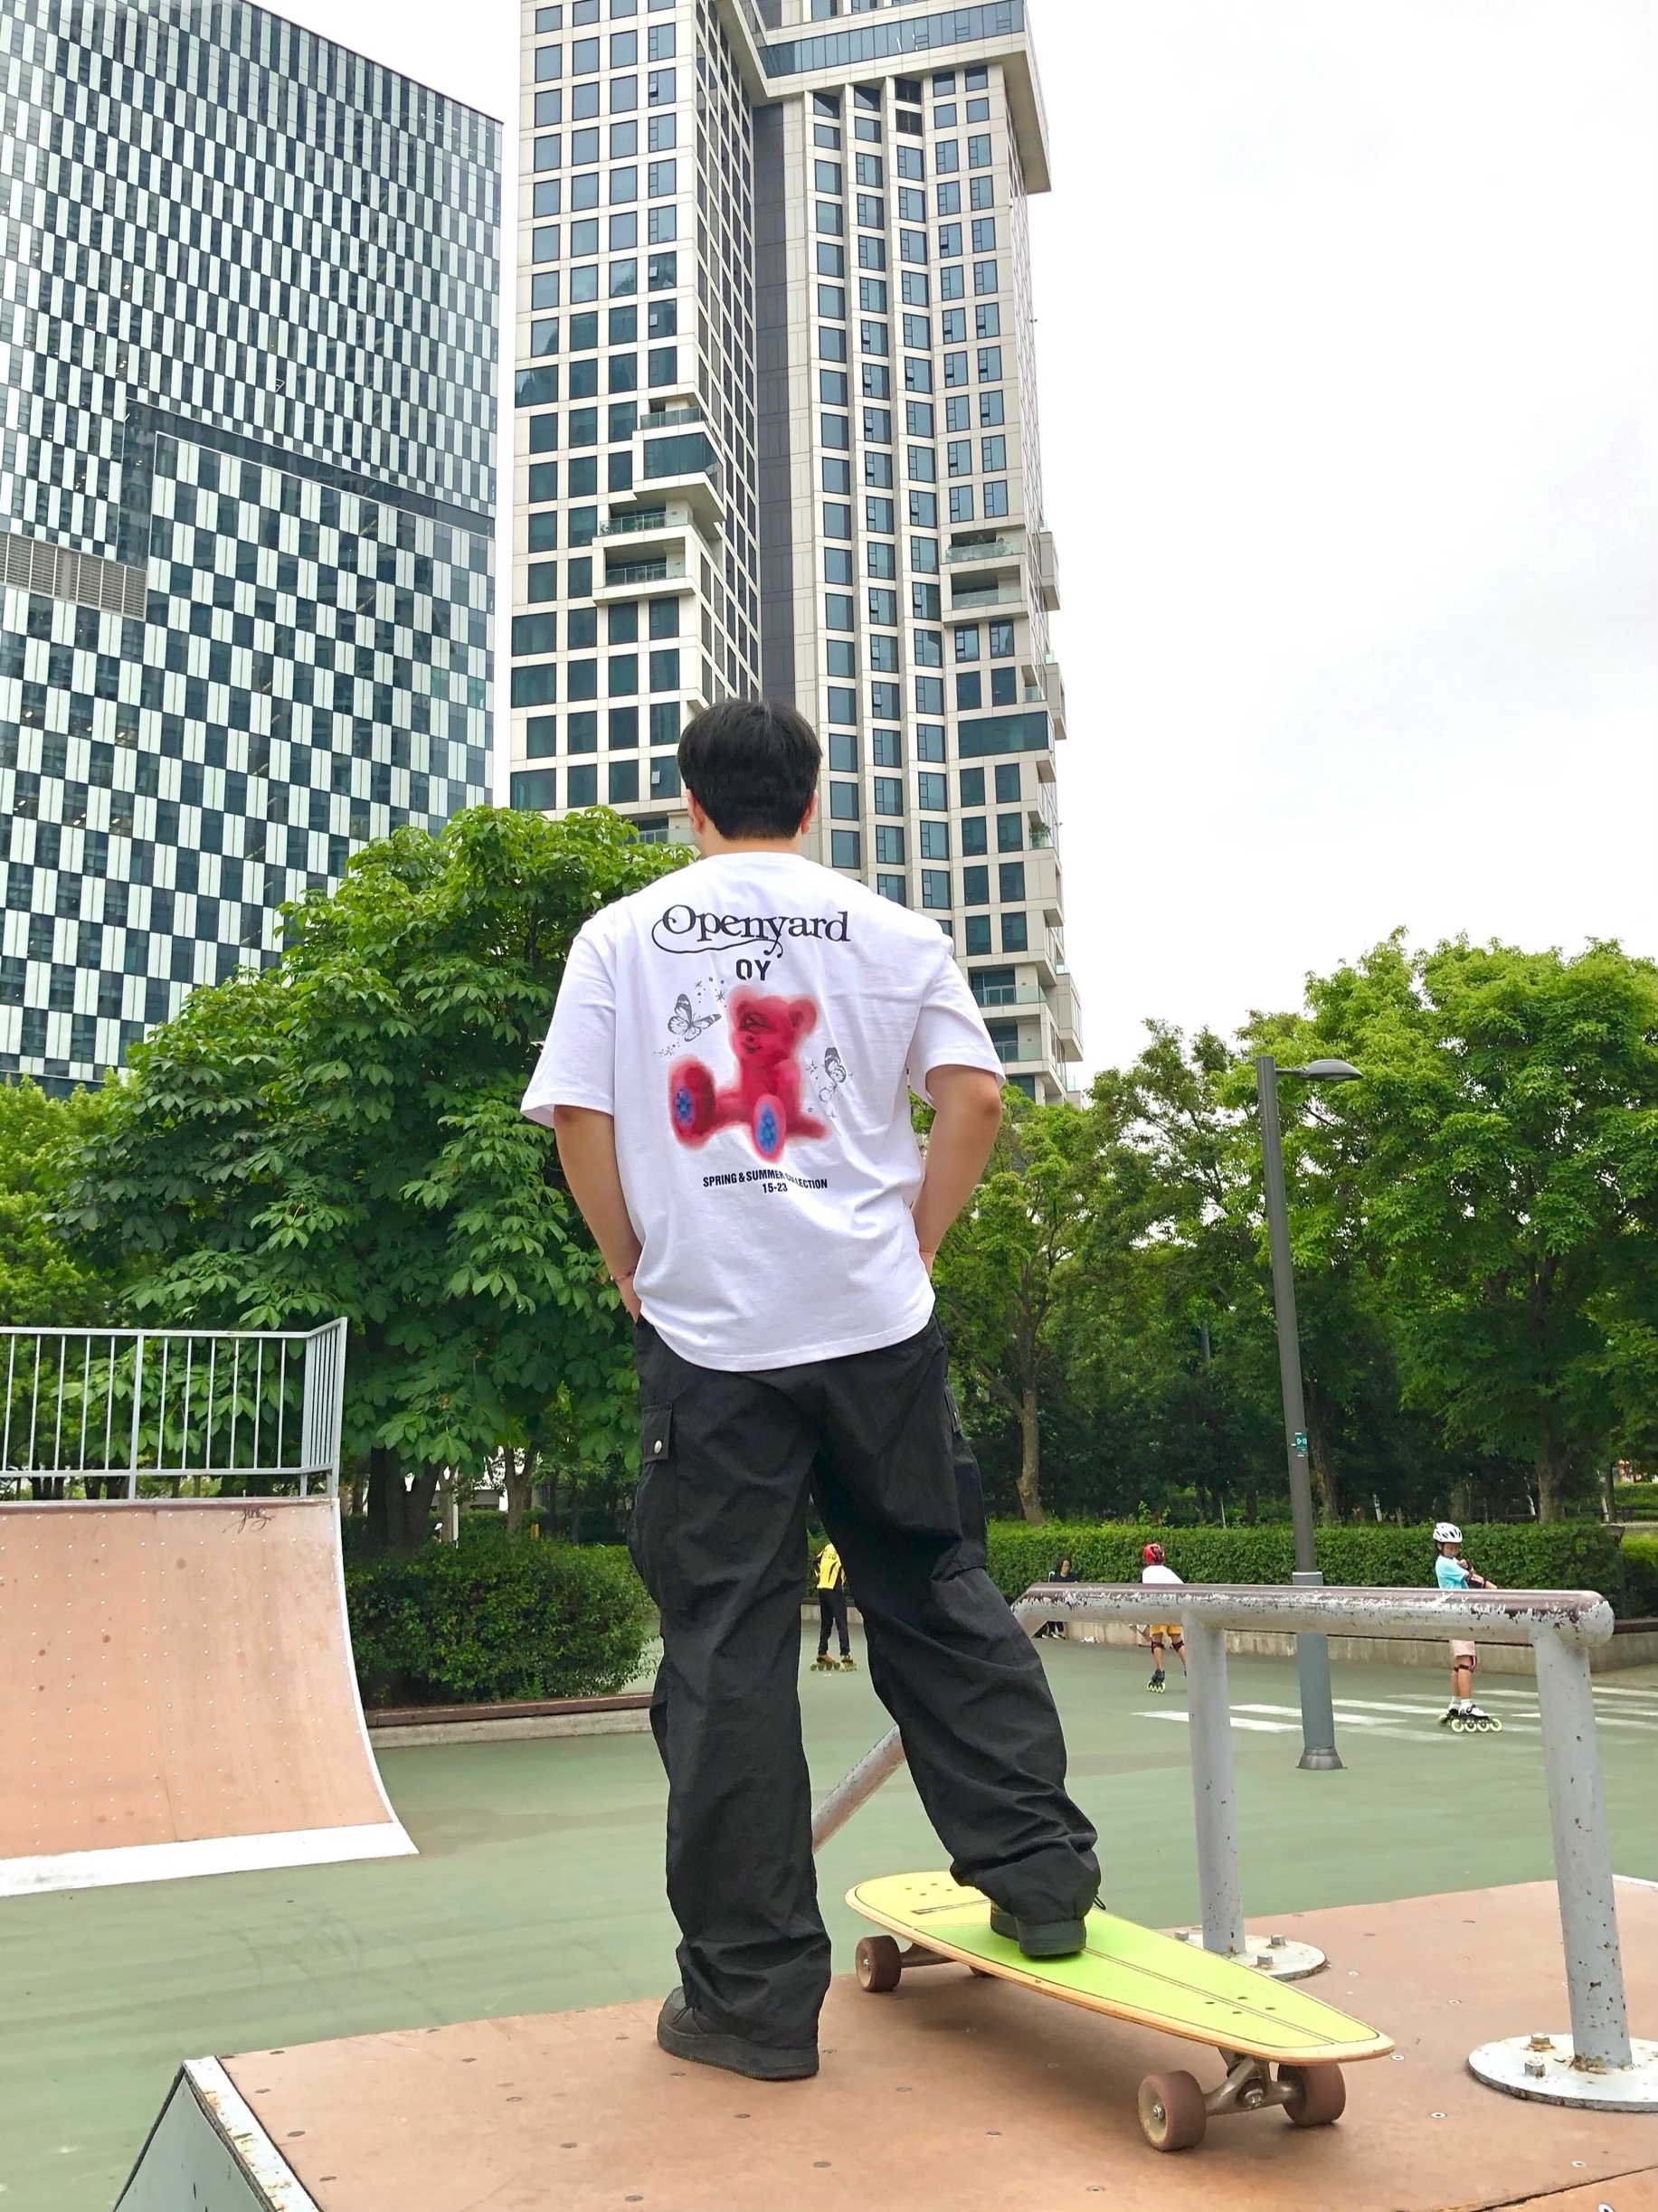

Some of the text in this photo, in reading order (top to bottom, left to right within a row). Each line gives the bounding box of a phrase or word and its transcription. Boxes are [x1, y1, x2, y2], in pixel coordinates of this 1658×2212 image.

[651, 904, 851, 958] Openyard
[735, 959, 771, 981] OY
[703, 1169, 828, 1189] SPRING & SUMMER COLECTION
[762, 1183, 788, 1193] 15-23
